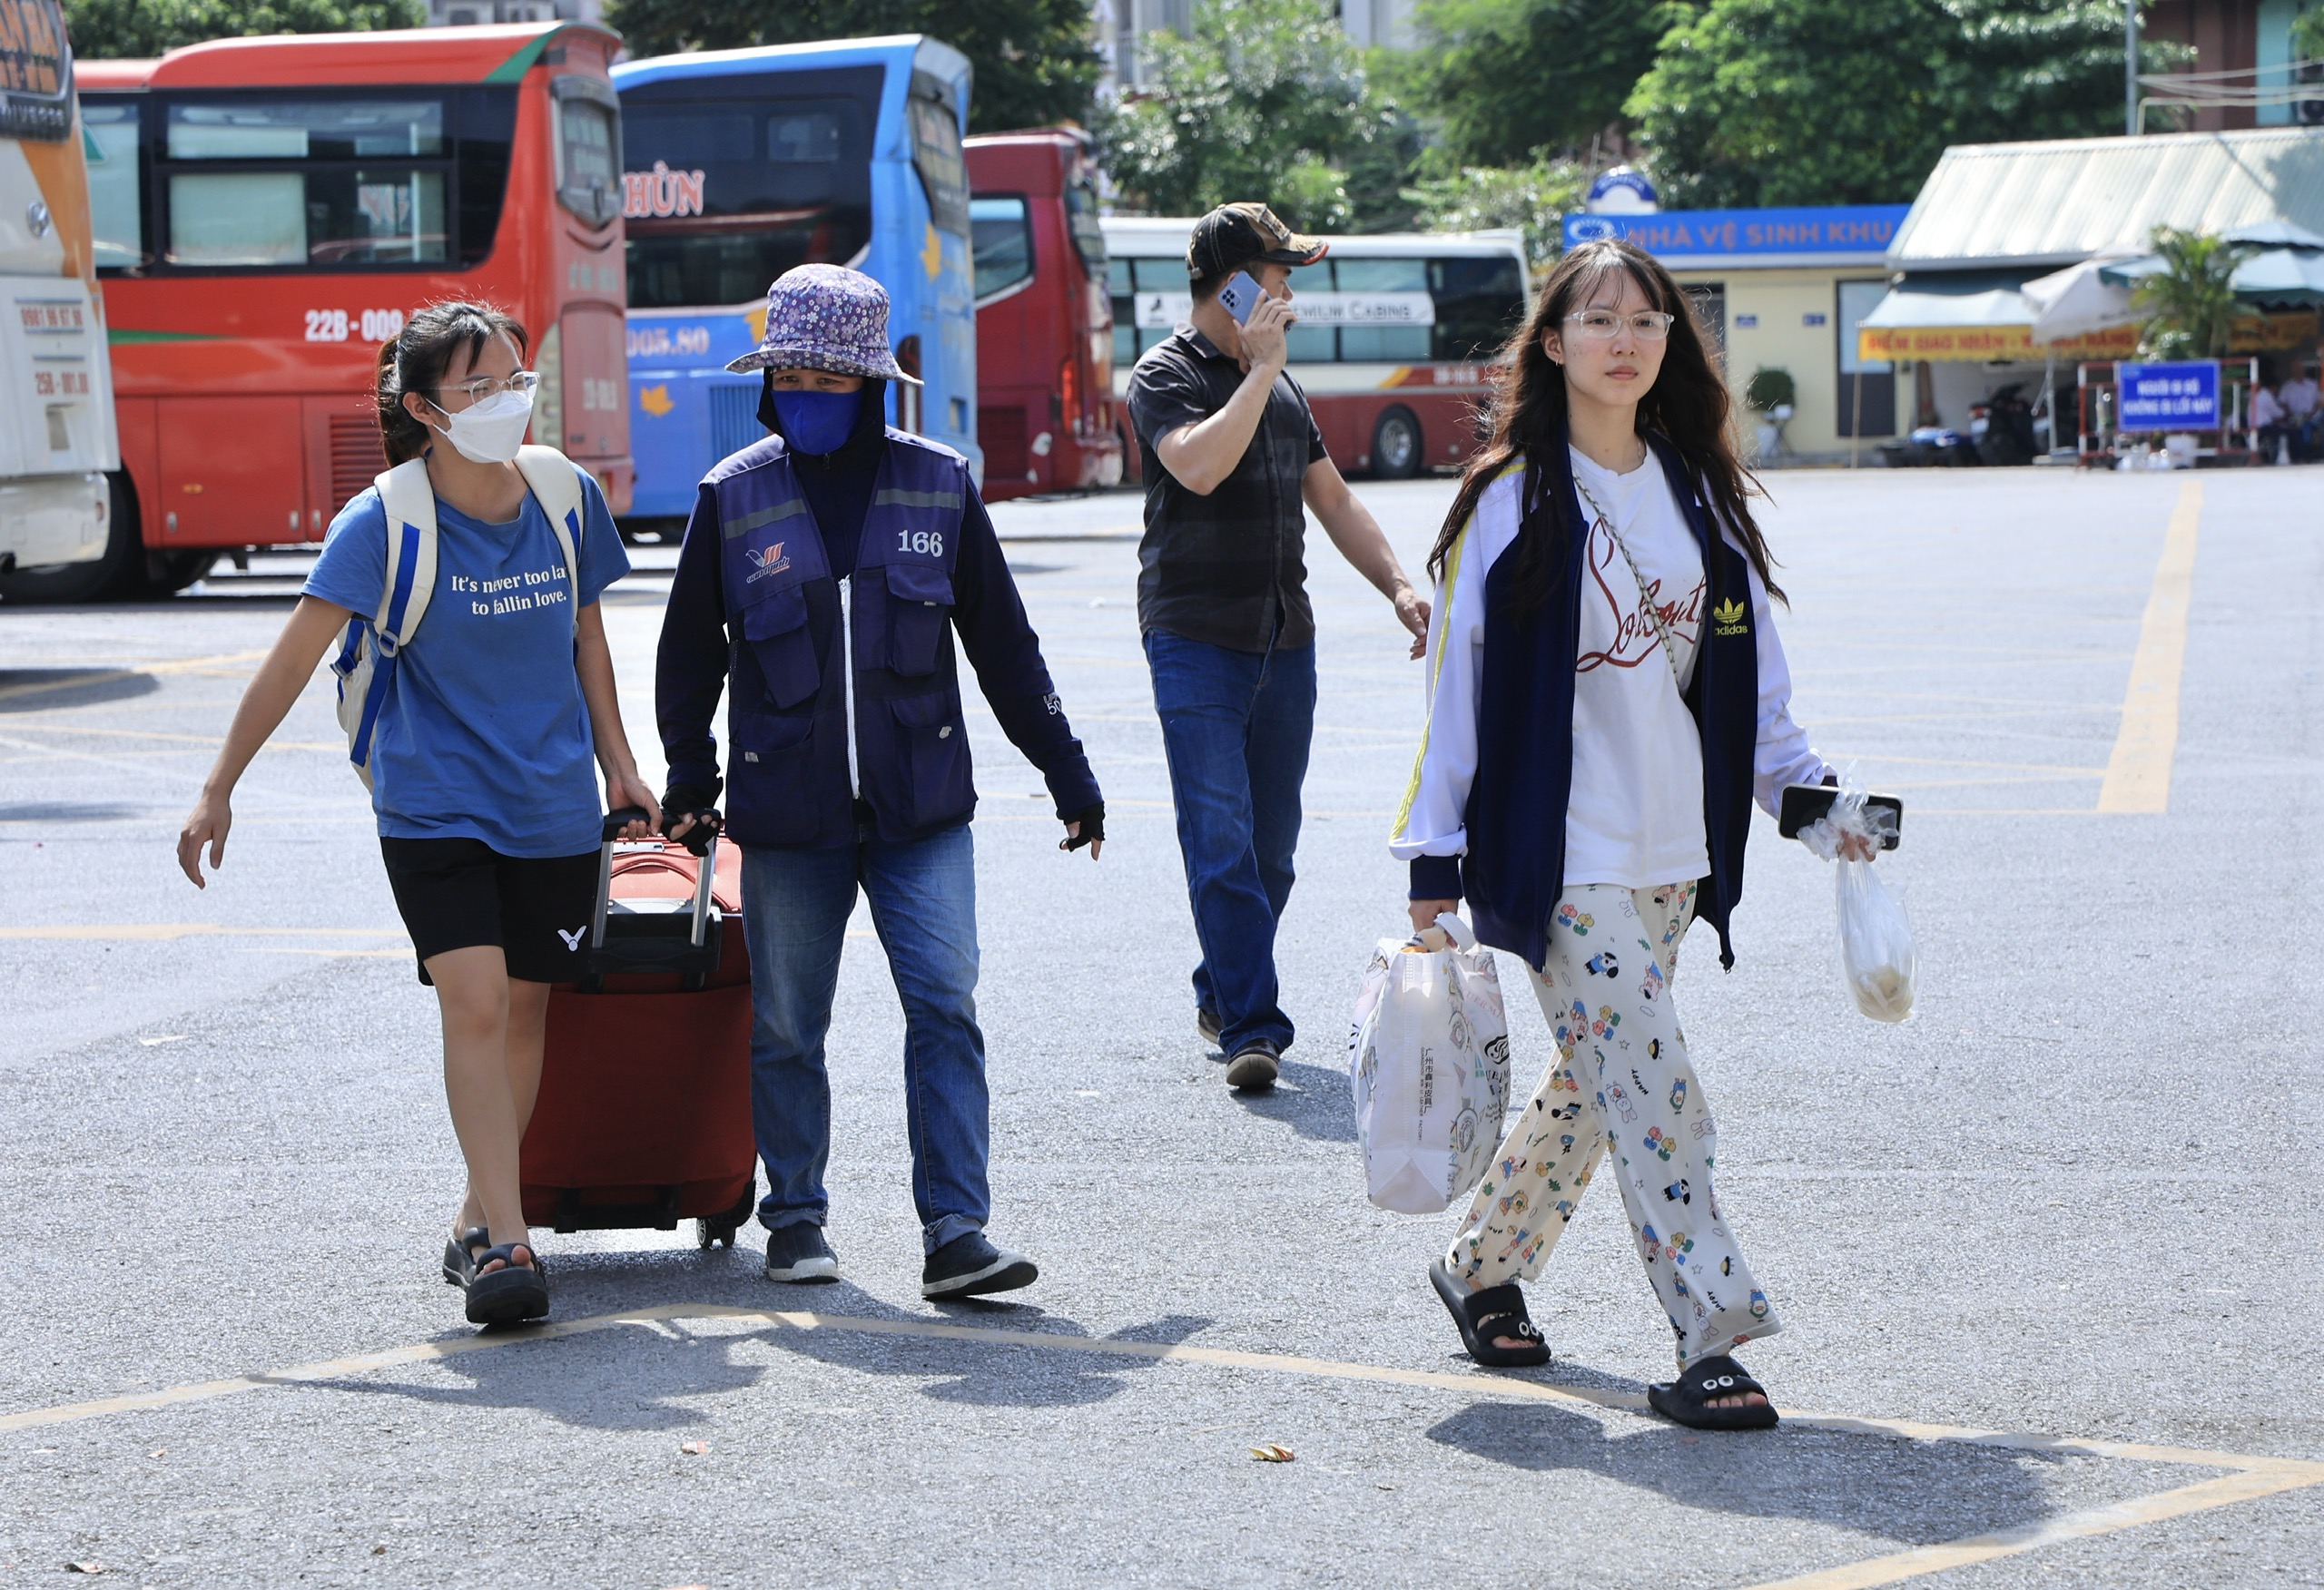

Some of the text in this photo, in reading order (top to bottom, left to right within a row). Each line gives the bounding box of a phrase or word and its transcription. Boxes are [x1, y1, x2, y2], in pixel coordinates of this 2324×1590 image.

[1746, 223, 1820, 246] SINH
[1827, 221, 1893, 243] KHU
[1294, 302, 1344, 319] EMIUM
[304, 309, 421, 342] 22B-009
[625, 326, 710, 358] 005.80
[898, 529, 943, 557] 166
[451, 564, 566, 594] It's never too la
[472, 600, 489, 615] to
[534, 590, 567, 608] love.
[1714, 623, 1748, 636] adidas
[1631, 1069, 1649, 1095] HAPPY
[1707, 1291, 1727, 1312] HAPPY
